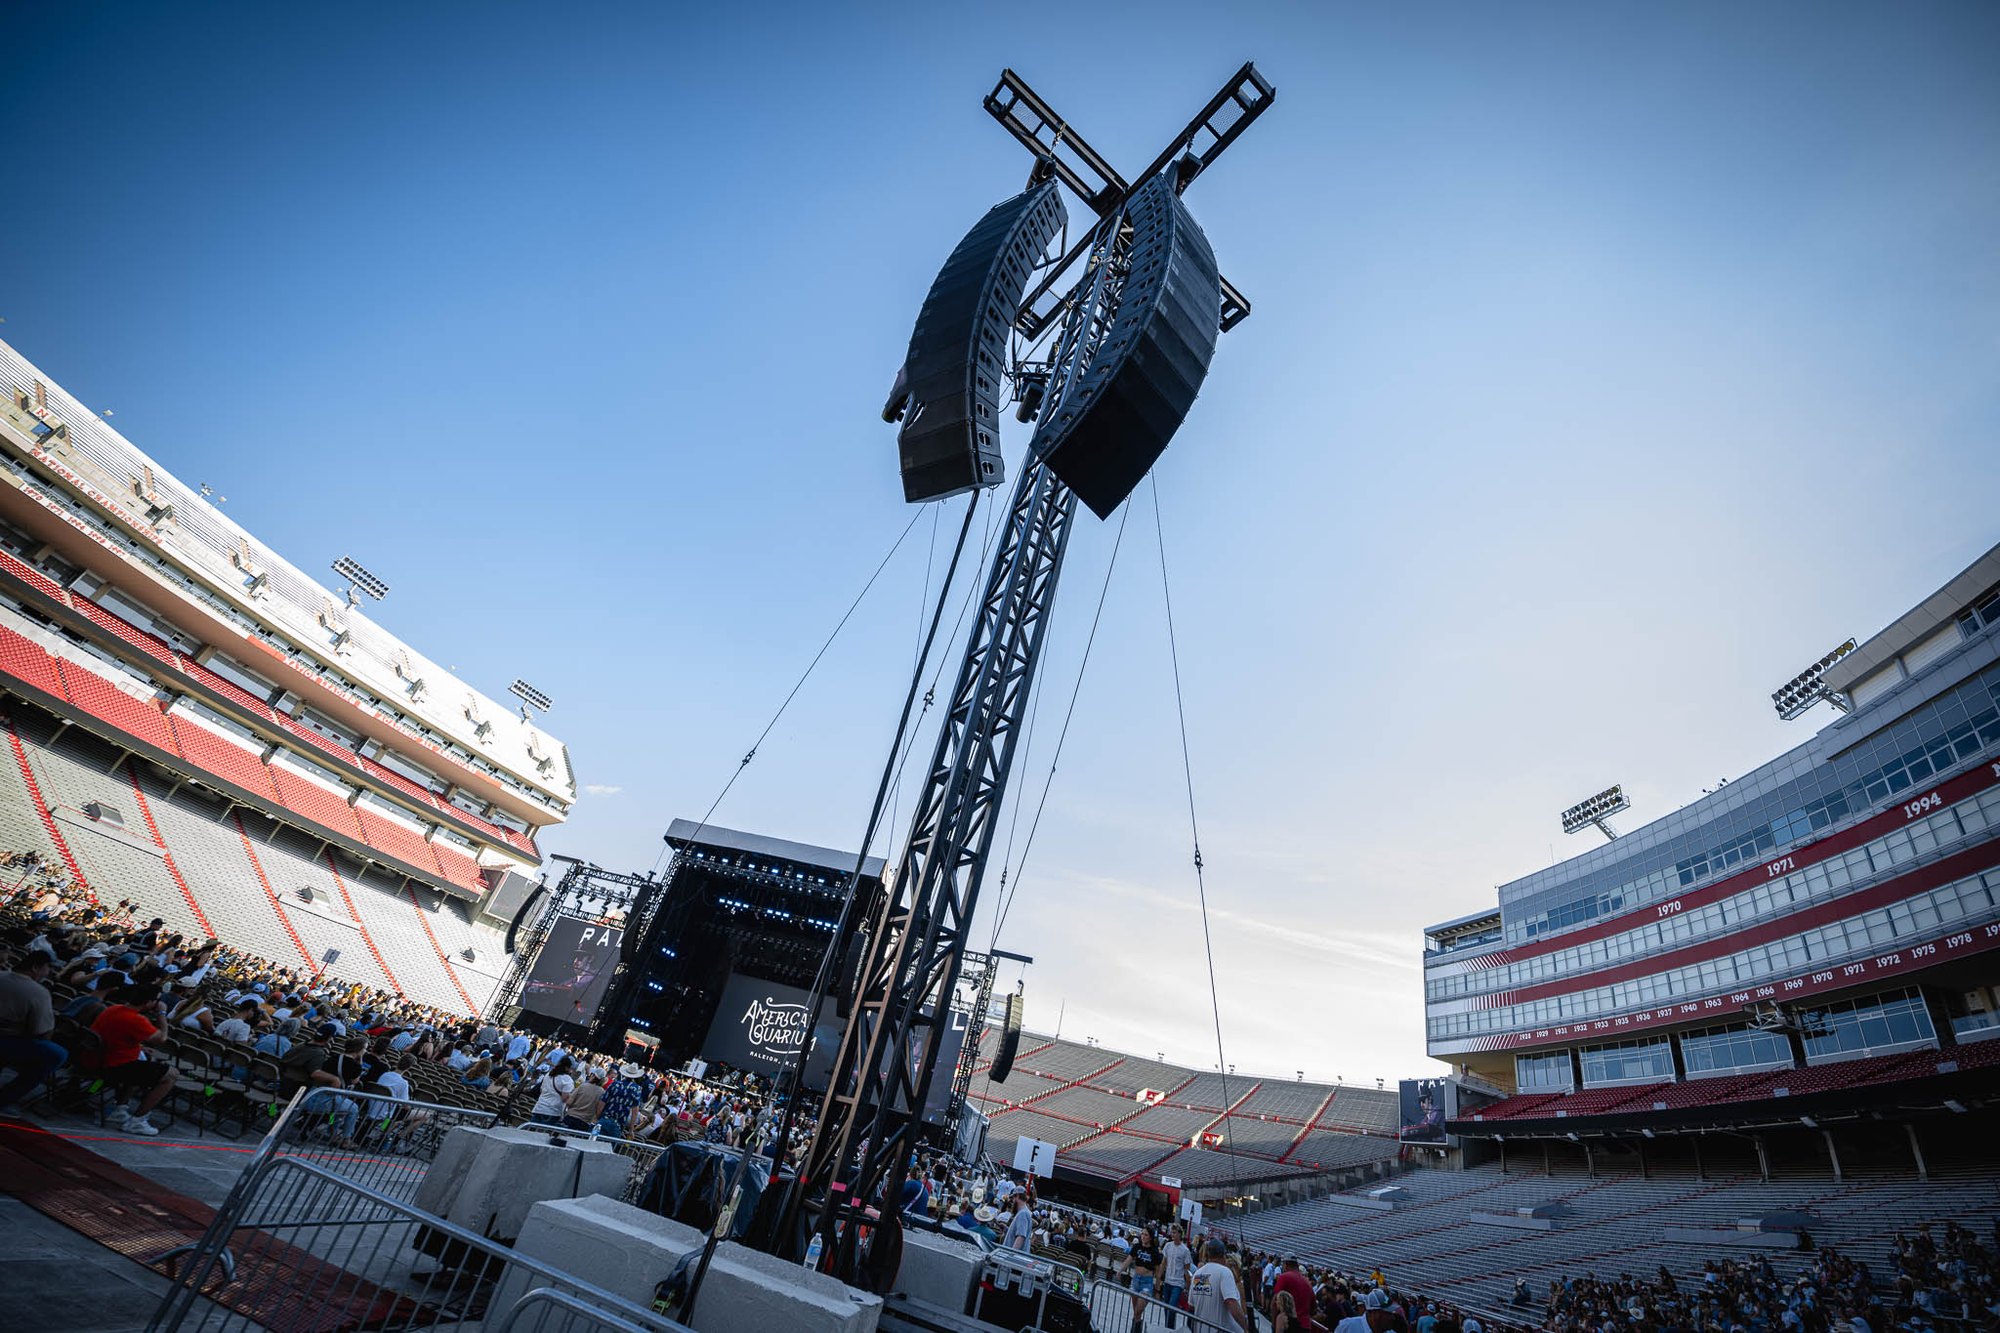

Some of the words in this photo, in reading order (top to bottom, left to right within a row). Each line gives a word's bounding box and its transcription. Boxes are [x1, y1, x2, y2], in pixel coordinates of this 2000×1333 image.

[36, 408, 49, 418] N
[23, 486, 43, 501] 1970
[47, 502, 64, 516] 1971
[31, 448, 84, 490] NATIONAL
[87, 489, 164, 546] CHAMPIONSHIPS
[146, 490, 158, 502] N
[1657, 900, 1682, 918] 1970
[1767, 857, 1795, 878] 1971
[1903, 791, 1942, 819] 1994
[1536, 1030, 1549, 1038] 1929
[1555, 1027, 1568, 1035] 1931
[1573, 1024, 1588, 1033] 1932
[1594, 1020, 1609, 1029] 1933
[1615, 1017, 1629, 1026] 1935
[1635, 1013, 1651, 1023] 1936
[1657, 1008, 1673, 1018] 1937
[1680, 1003, 1697, 1014] 1940
[1704, 998, 1722, 1009] 1963
[1731, 992, 1749, 1003] 1964
[1756, 986, 1775, 998] 1966
[1783, 979, 1803, 991] 1969
[1812, 971, 1833, 985] 1970
[1843, 963, 1865, 976] 1971
[1876, 954, 1901, 968] 1972
[1911, 943, 1936, 959] 1975
[1946, 933, 1973, 949] 1978
[1030, 1145, 1040, 1163] F
